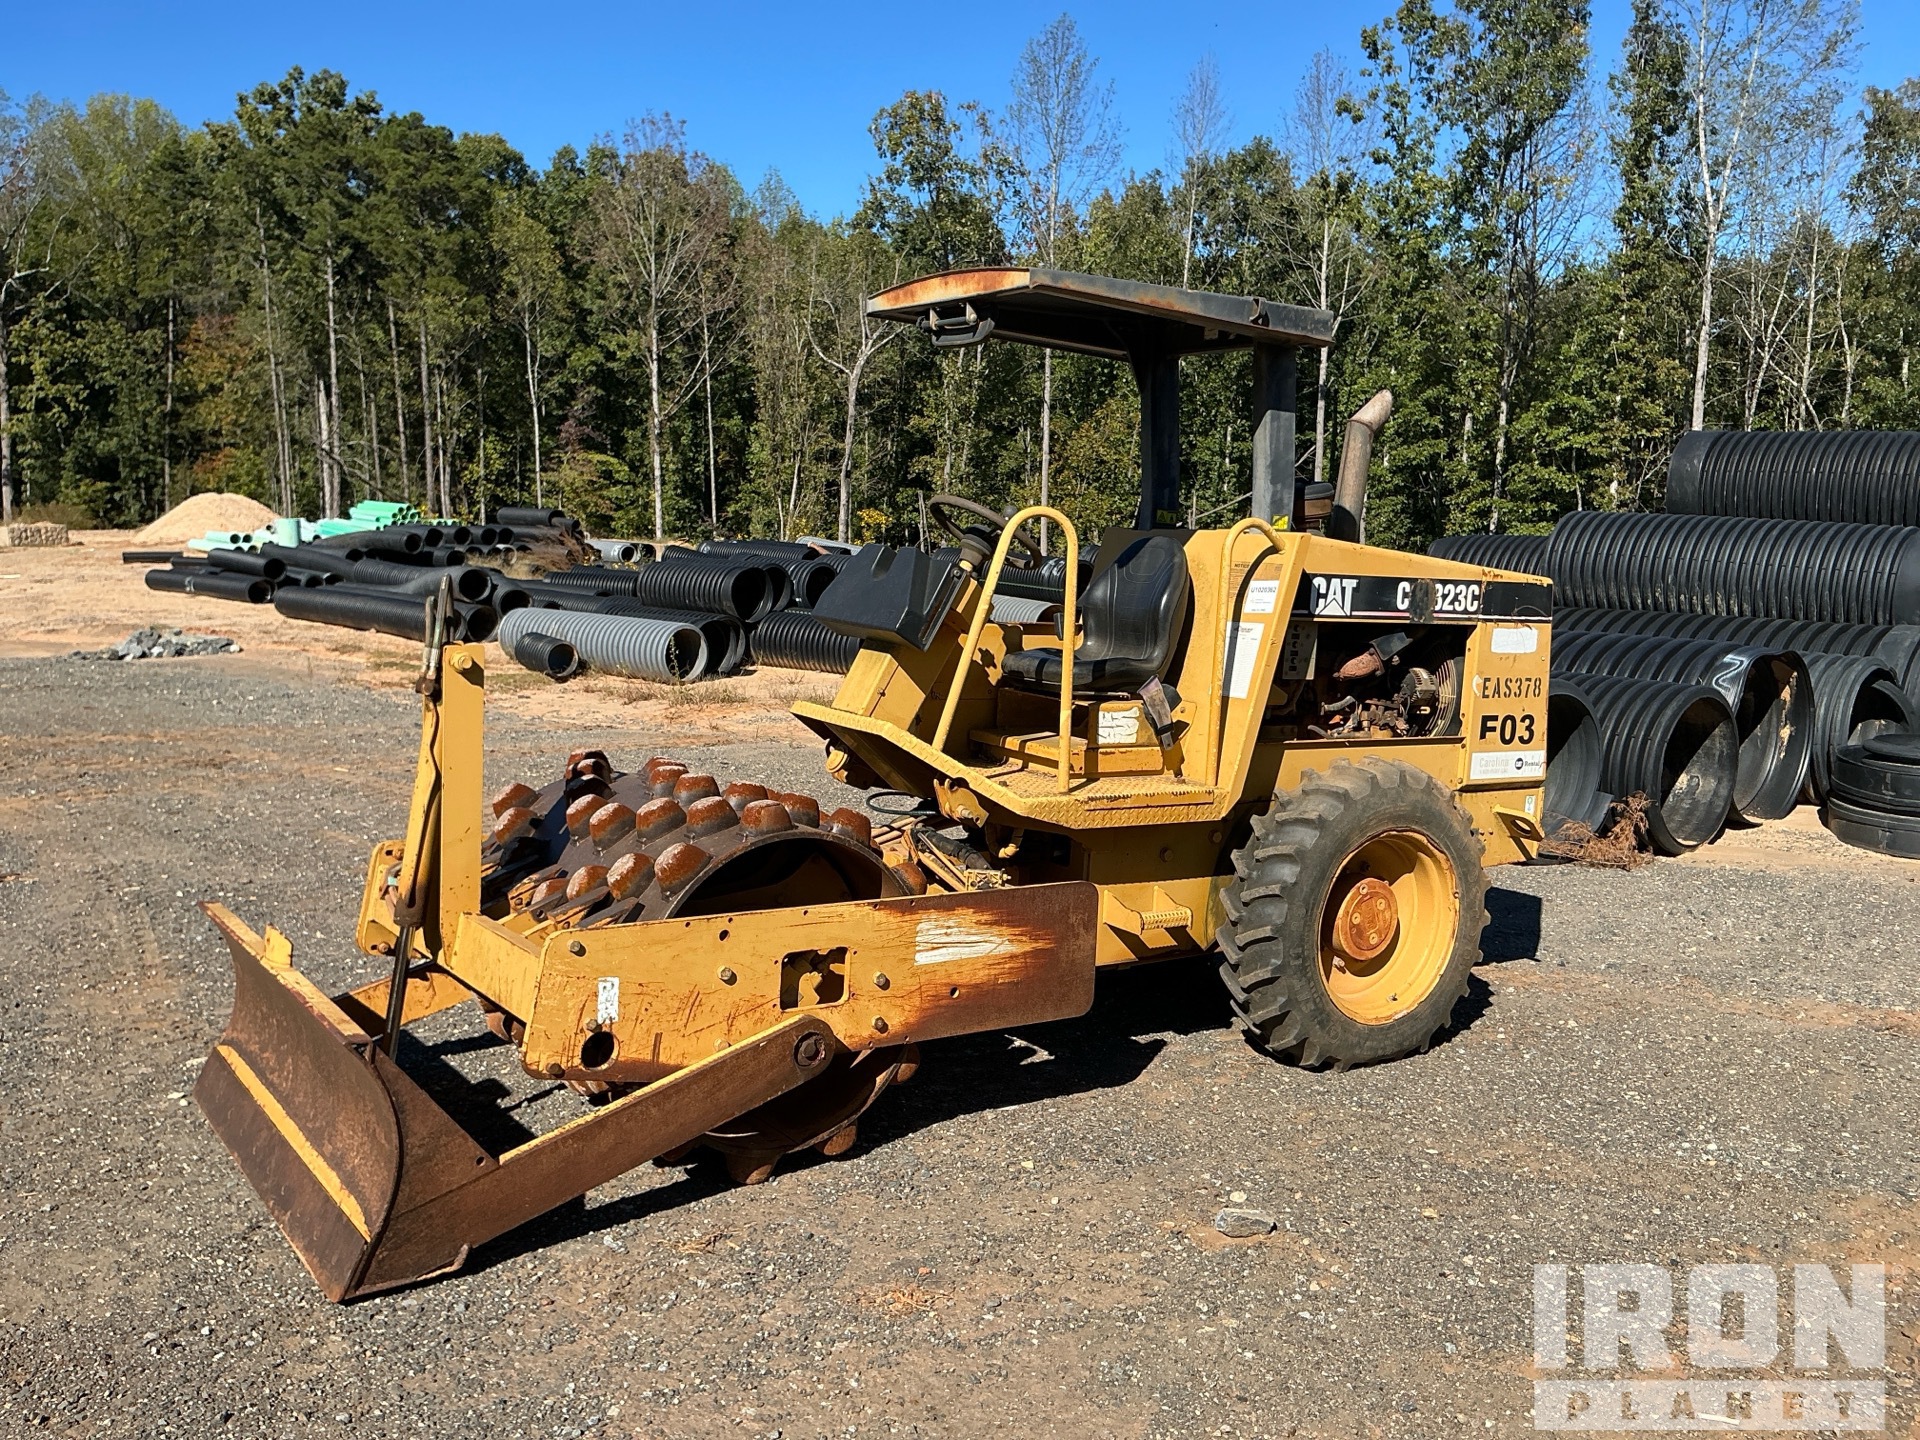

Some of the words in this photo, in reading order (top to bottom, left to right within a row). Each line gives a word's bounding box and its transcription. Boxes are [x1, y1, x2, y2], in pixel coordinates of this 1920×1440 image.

[1309, 576, 1360, 616] CAT
[1396, 581, 1480, 612] C323C
[1482, 677, 1542, 698] EAS378
[1479, 714, 1535, 745] F03
